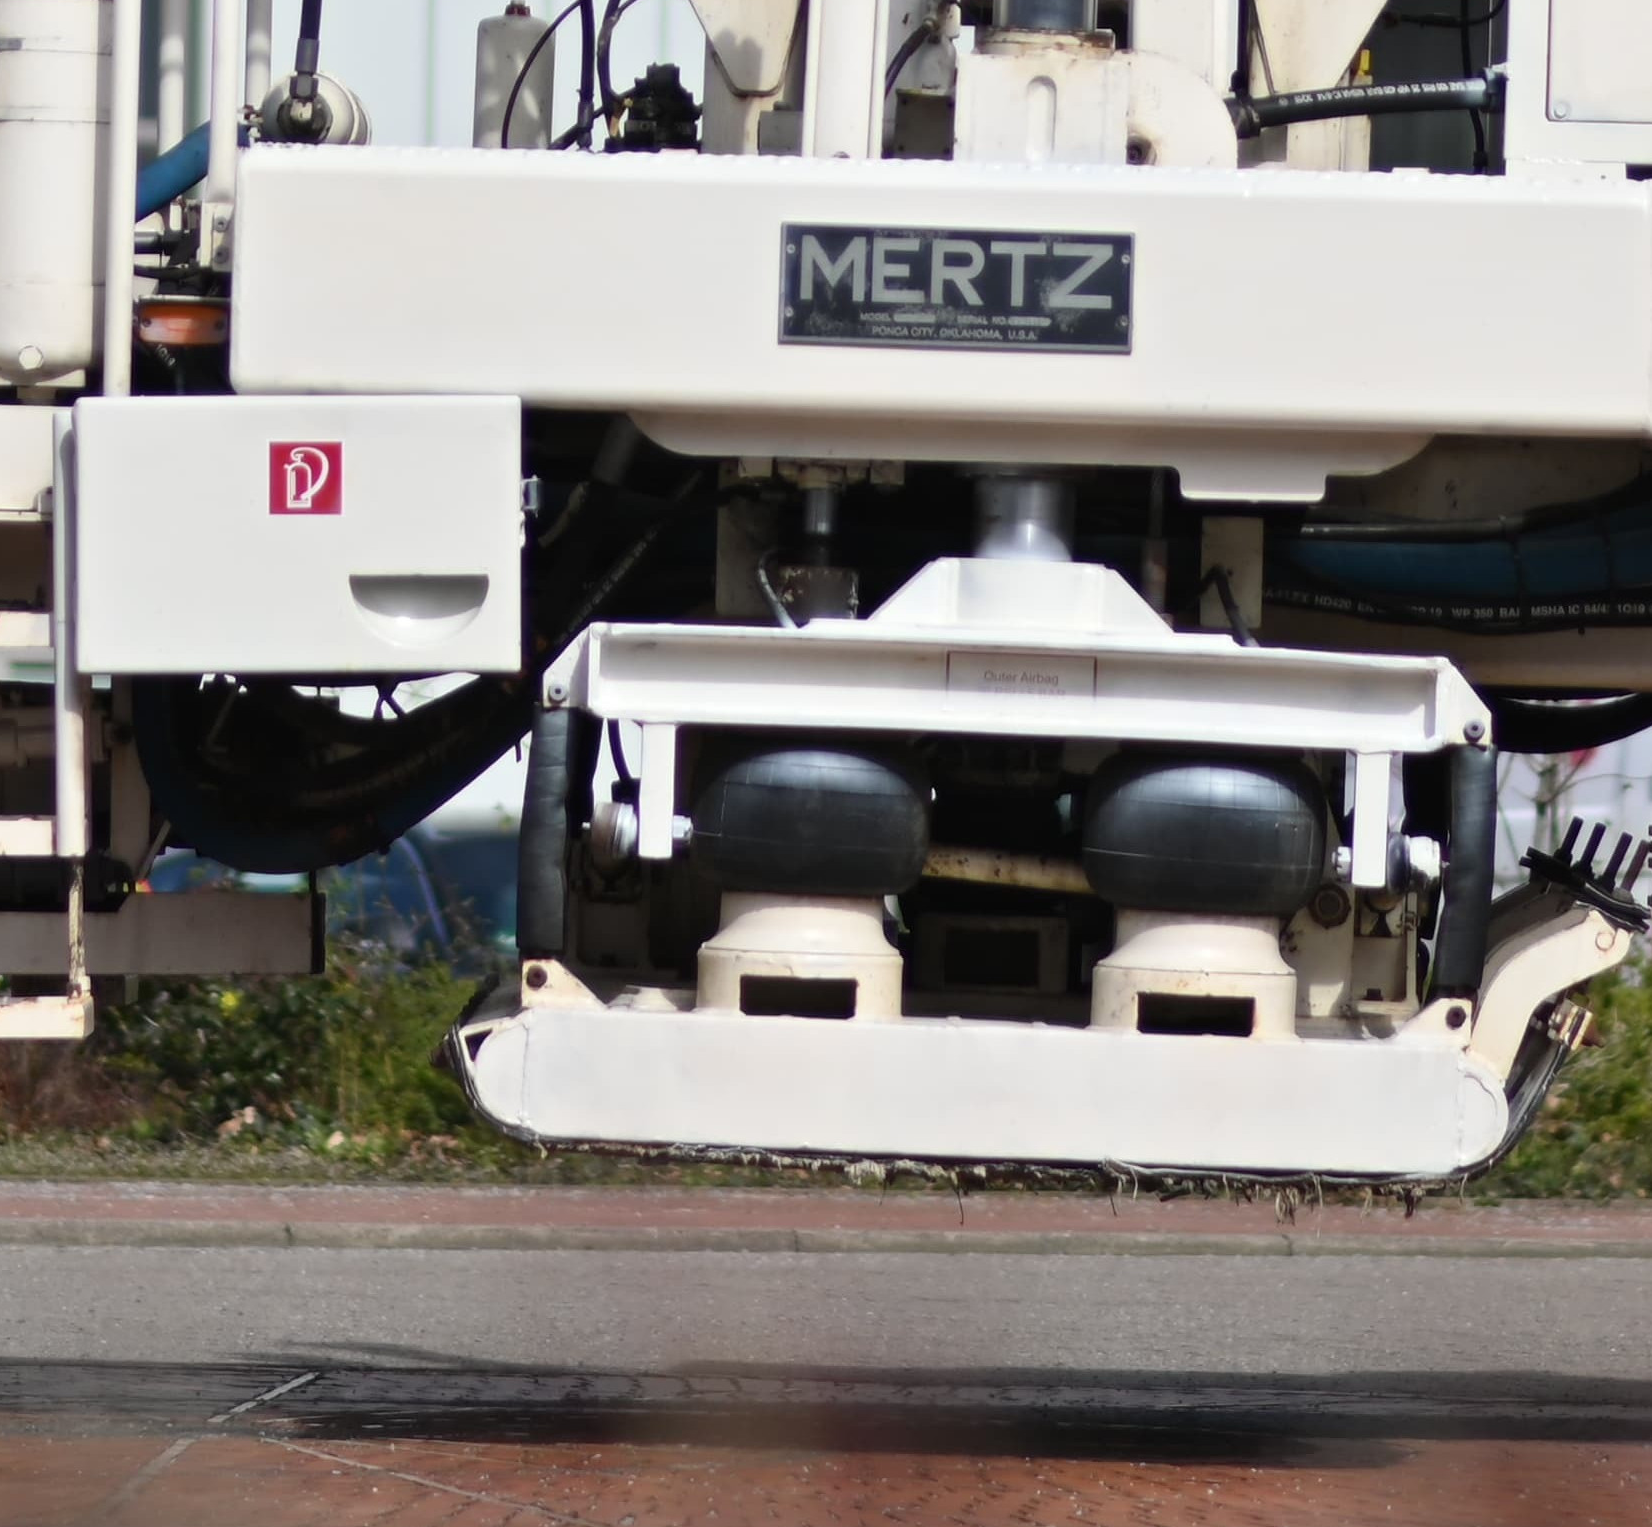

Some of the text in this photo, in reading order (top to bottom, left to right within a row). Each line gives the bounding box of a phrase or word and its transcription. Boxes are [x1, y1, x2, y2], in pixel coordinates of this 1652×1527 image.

[799, 233, 1114, 310] MERTZ
[871, 325, 909, 337] PONCA
[1530, 605, 1566, 617] MSHA
[983, 669, 1060, 687] Outer Airbag
